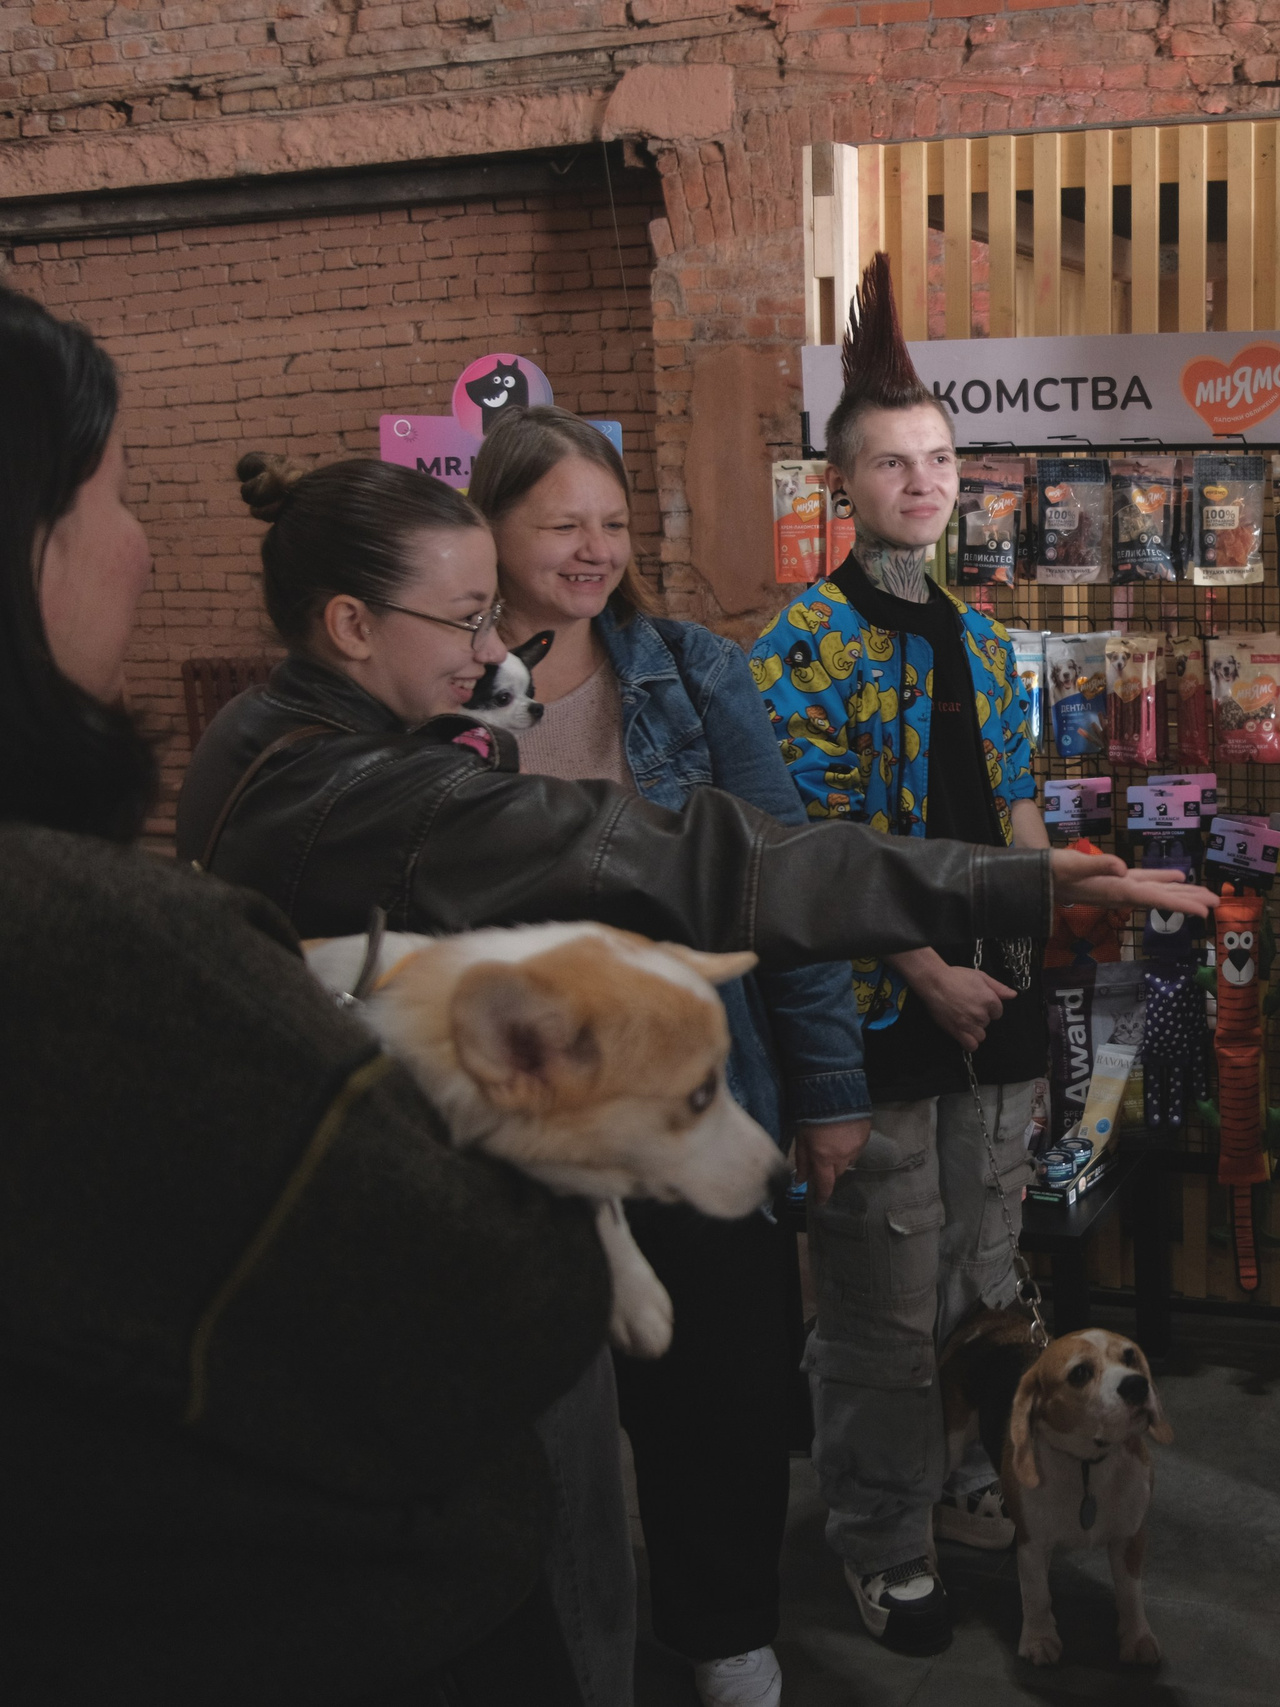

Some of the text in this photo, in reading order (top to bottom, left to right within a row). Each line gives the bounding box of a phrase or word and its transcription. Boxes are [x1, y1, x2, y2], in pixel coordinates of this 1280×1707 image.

[933, 375, 1153, 414] КОМСТВА
[1213, 413, 1245, 423] ЛАПОЧКИ
[416, 456, 476, 476] MR.
[1047, 510, 1076, 519] 100%
[1205, 509, 1236, 519] 100%
[963, 552, 1013, 564] ДЕЛИКАТЕС
[1116, 549, 1163, 559] ДЕЛИКАТЕС
[1236, 683, 1273, 699] МНЯМС
[1060, 703, 1092, 714] ДЕНТАЛ
[1055, 988, 1091, 1105] Award
